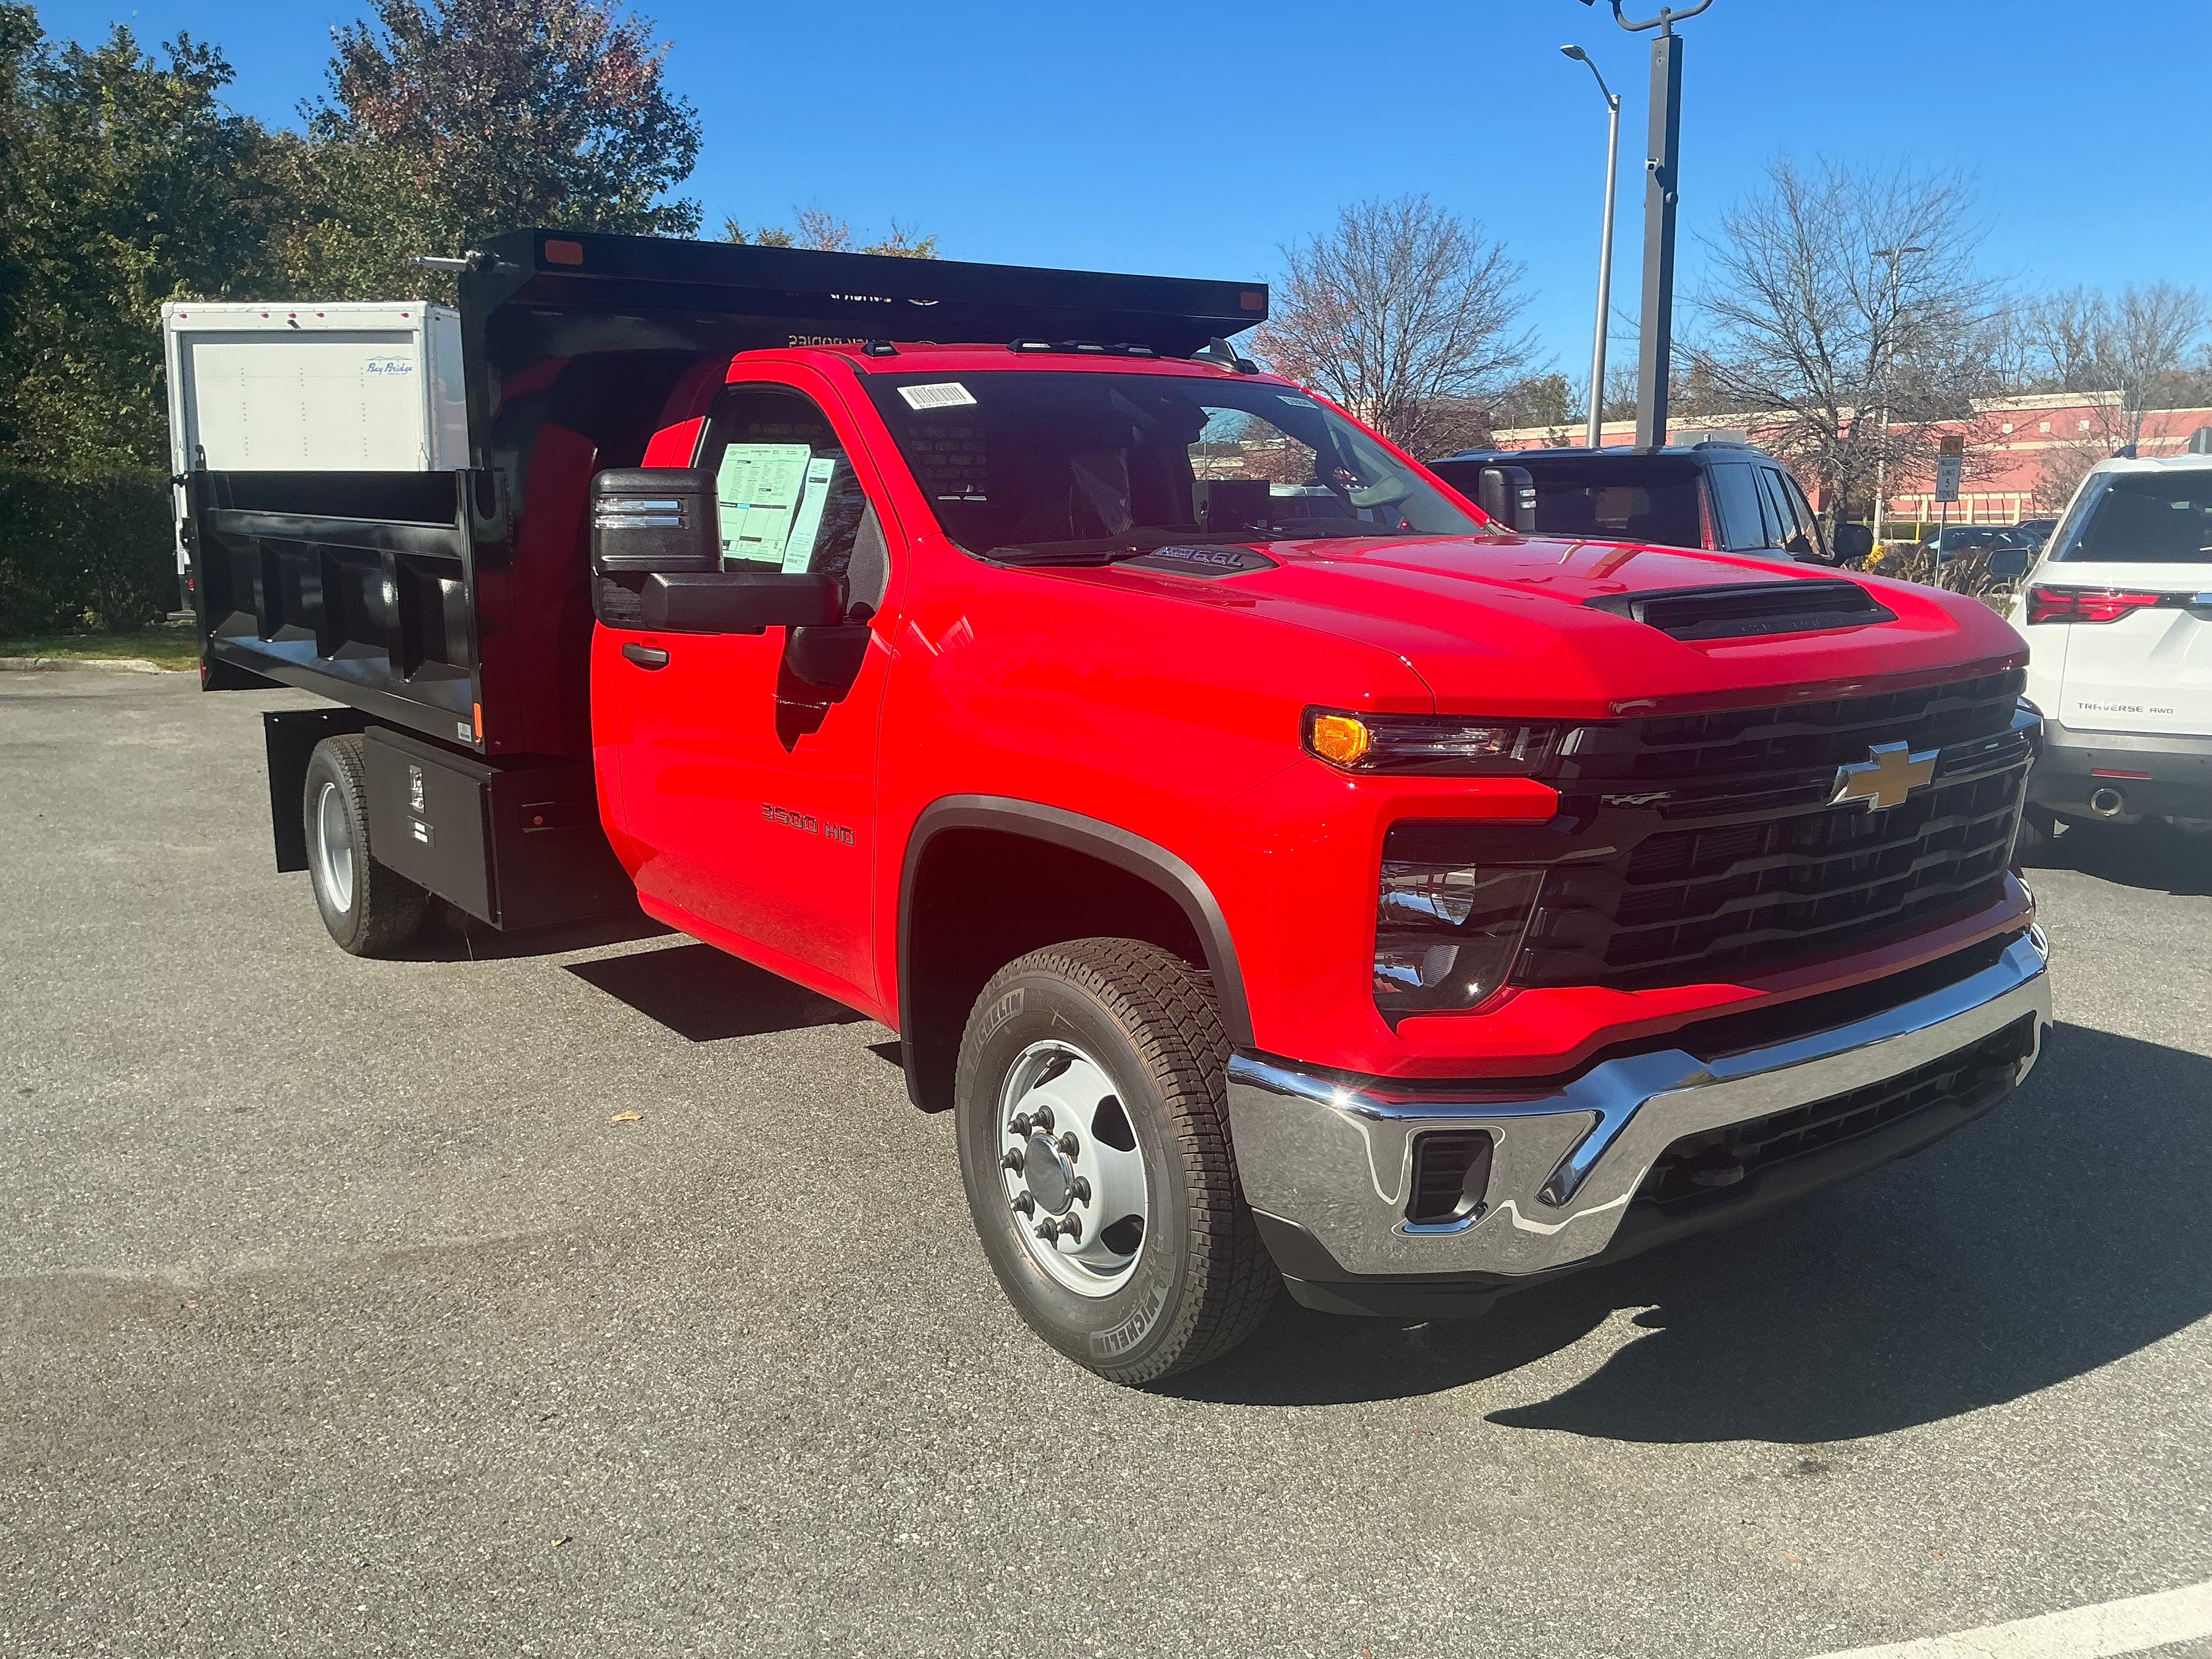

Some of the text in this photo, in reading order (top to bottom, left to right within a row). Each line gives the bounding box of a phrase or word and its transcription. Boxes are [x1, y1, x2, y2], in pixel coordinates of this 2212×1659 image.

[366, 362, 413, 375] Bay Bridge
[1945, 478, 1950, 488] 5
[1938, 490, 1955, 499] TONS
[2078, 702, 2144, 713] TRAVERSE
[760, 802, 856, 847] 3500 HD
[968, 992, 1022, 1068] MICHELIN
[1092, 1287, 1160, 1354] MICHELIN
